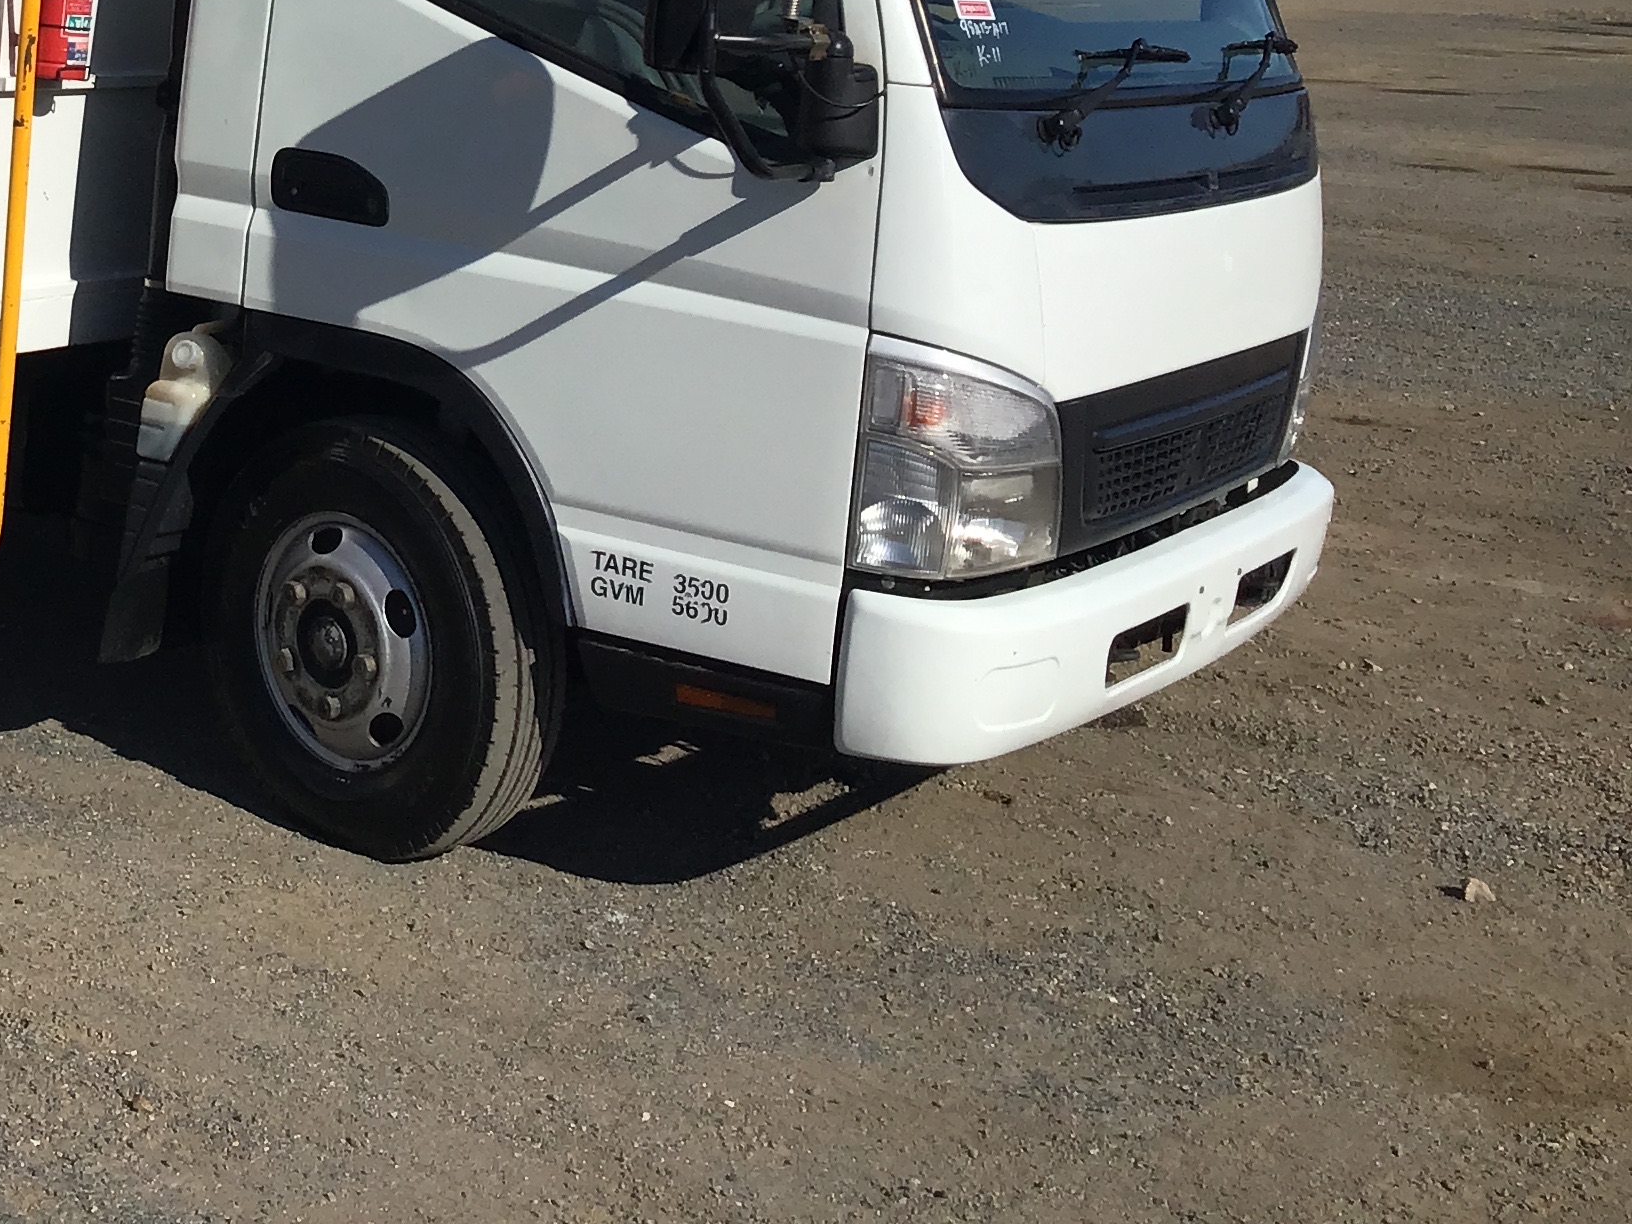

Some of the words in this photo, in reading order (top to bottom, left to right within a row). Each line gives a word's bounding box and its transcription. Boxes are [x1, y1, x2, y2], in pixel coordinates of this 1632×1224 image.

[590, 576, 645, 606] GVM
[591, 550, 654, 583] TARE
[673, 573, 730, 604] 3500
